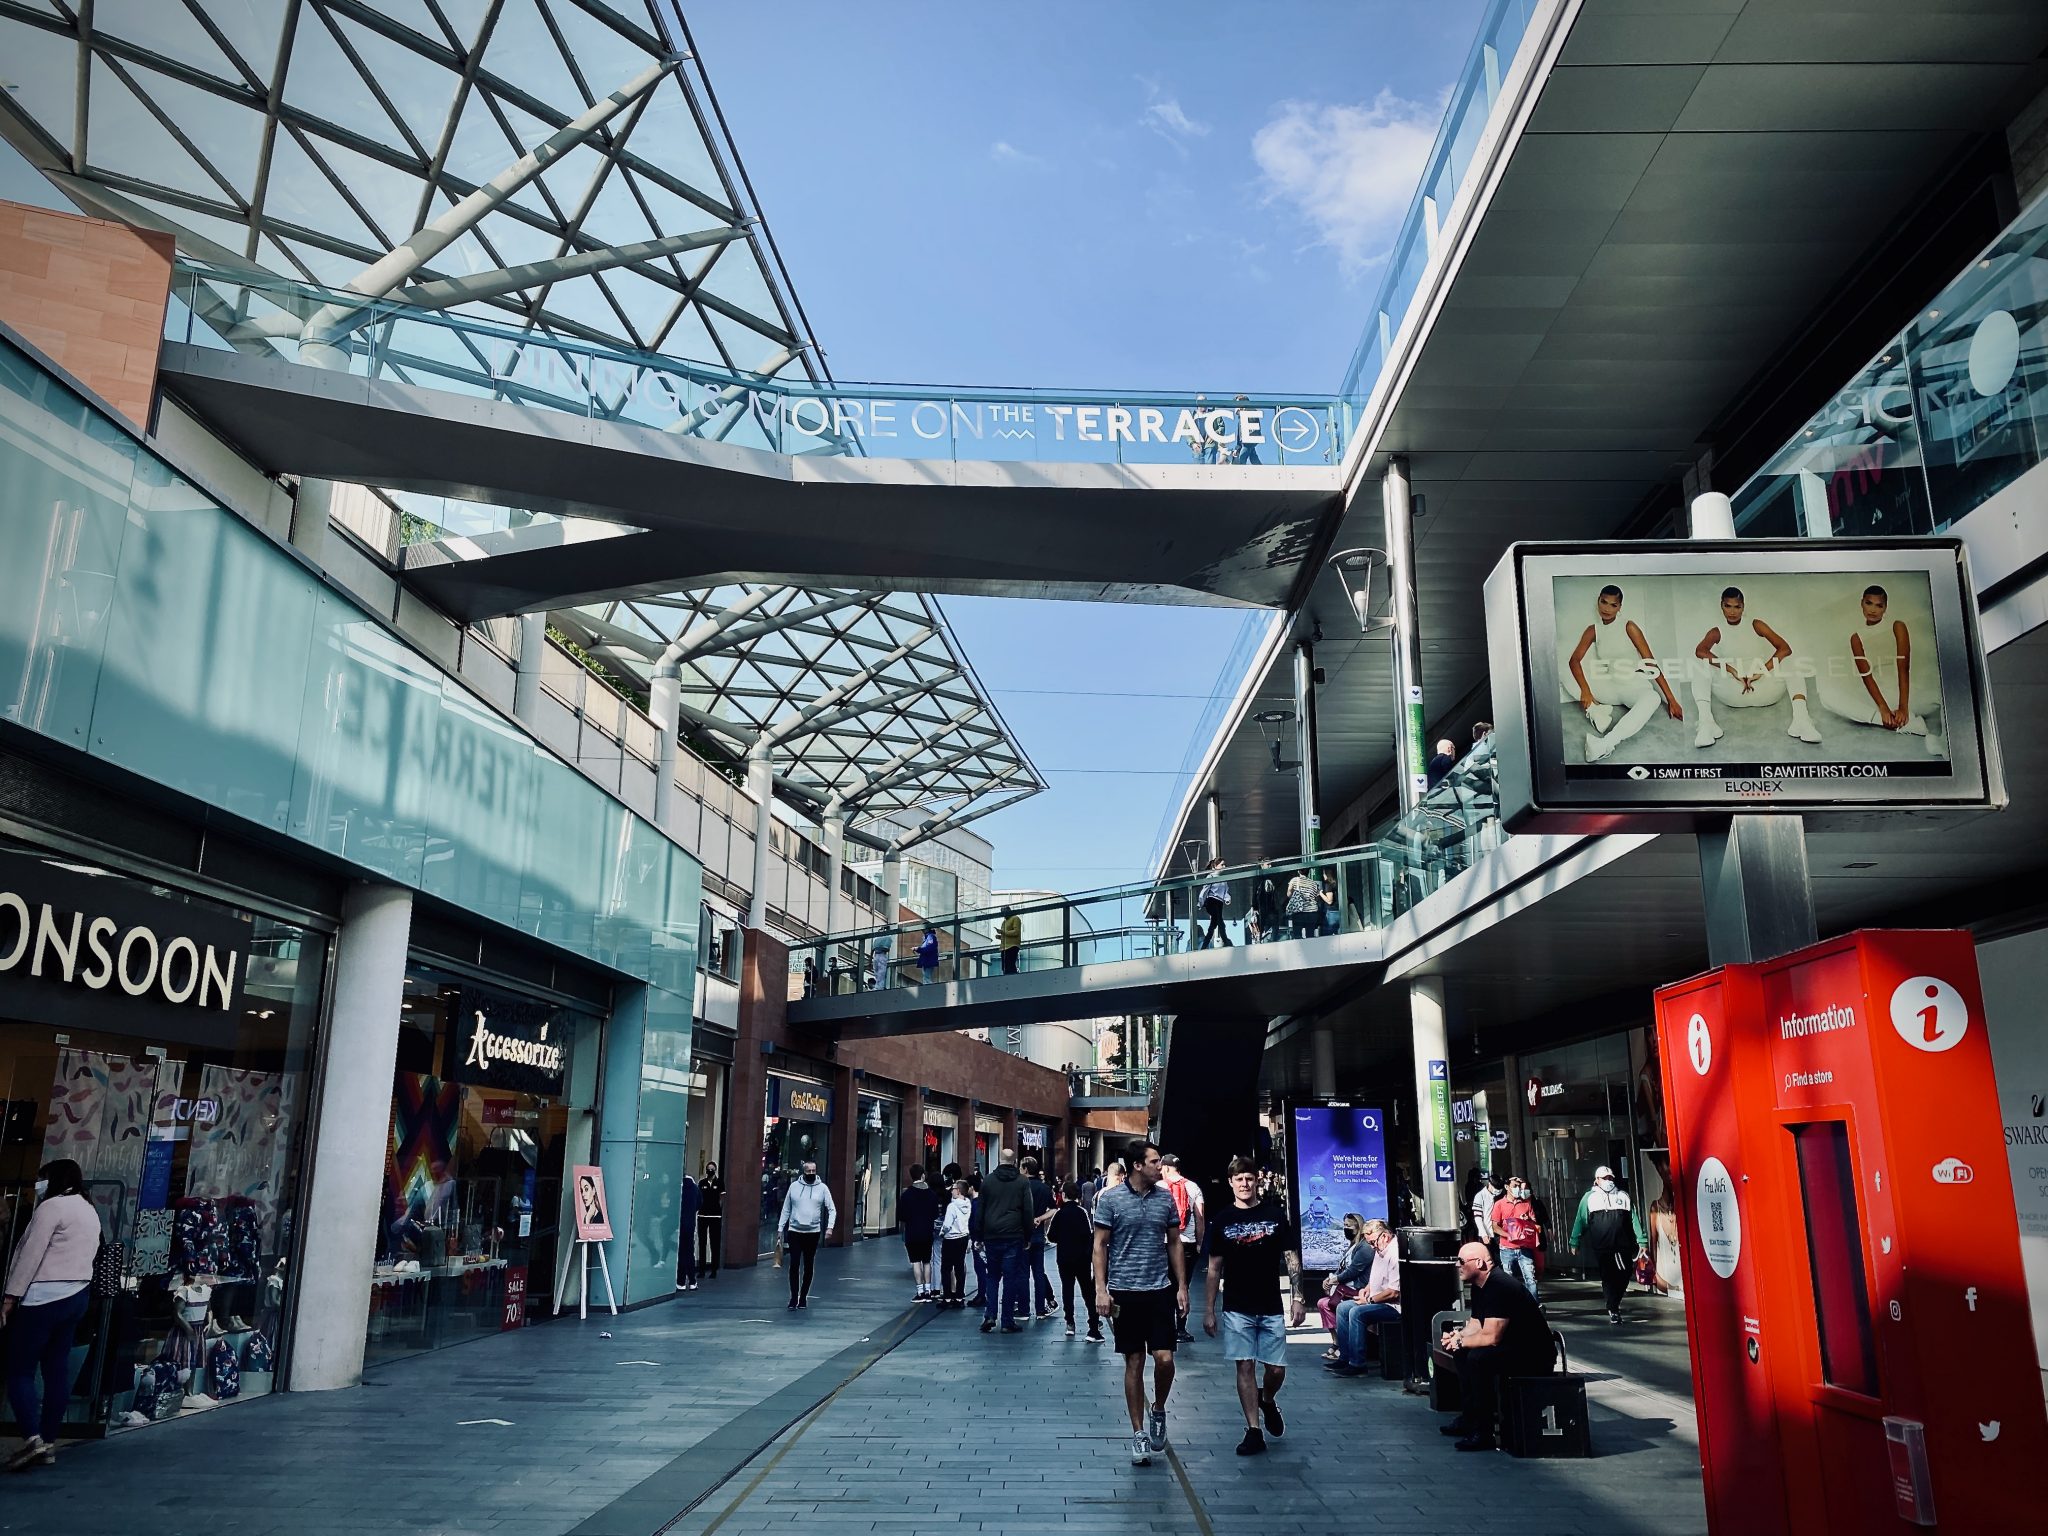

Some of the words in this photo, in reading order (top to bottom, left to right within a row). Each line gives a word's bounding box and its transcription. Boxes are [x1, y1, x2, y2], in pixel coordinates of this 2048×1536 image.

[748, 389, 899, 438] MORE
[910, 401, 984, 440] ON
[988, 404, 1036, 423] THE
[1045, 406, 1266, 444] TERRACE
[1590, 655, 1817, 681] ESSENTIALS
[1829, 655, 1906, 678] EDIT
[1659, 768, 1681, 779] SAW
[1682, 768, 1693, 778] IT
[1694, 767, 1723, 779] FIRST
[1760, 765, 1889, 779] ISAWITFIRST.COM
[1725, 780, 1784, 793] ELONEX
[1780, 1003, 1856, 1040] Information
[465, 1010, 560, 1070] Accessorize
[1792, 1073, 1808, 1087] Find
[1814, 1070, 1833, 1083] store
[1436, 1084, 1444, 1103] LEFT
[1438, 1105, 1446, 1120] THE
[1439, 1122, 1446, 1135] TO
[1440, 1136, 1448, 1157] KEEP
[1332, 1154, 1352, 1162] We're
[1352, 1154, 1367, 1162] here
[1368, 1154, 1379, 1162] for
[1333, 1162, 1346, 1170] you
[1346, 1161, 1379, 1169] whenever
[1333, 1169, 1346, 1177] you
[1347, 1168, 1364, 1176] need
[507, 1280, 524, 1294] SALE
[1541, 1405, 1563, 1436] 1
